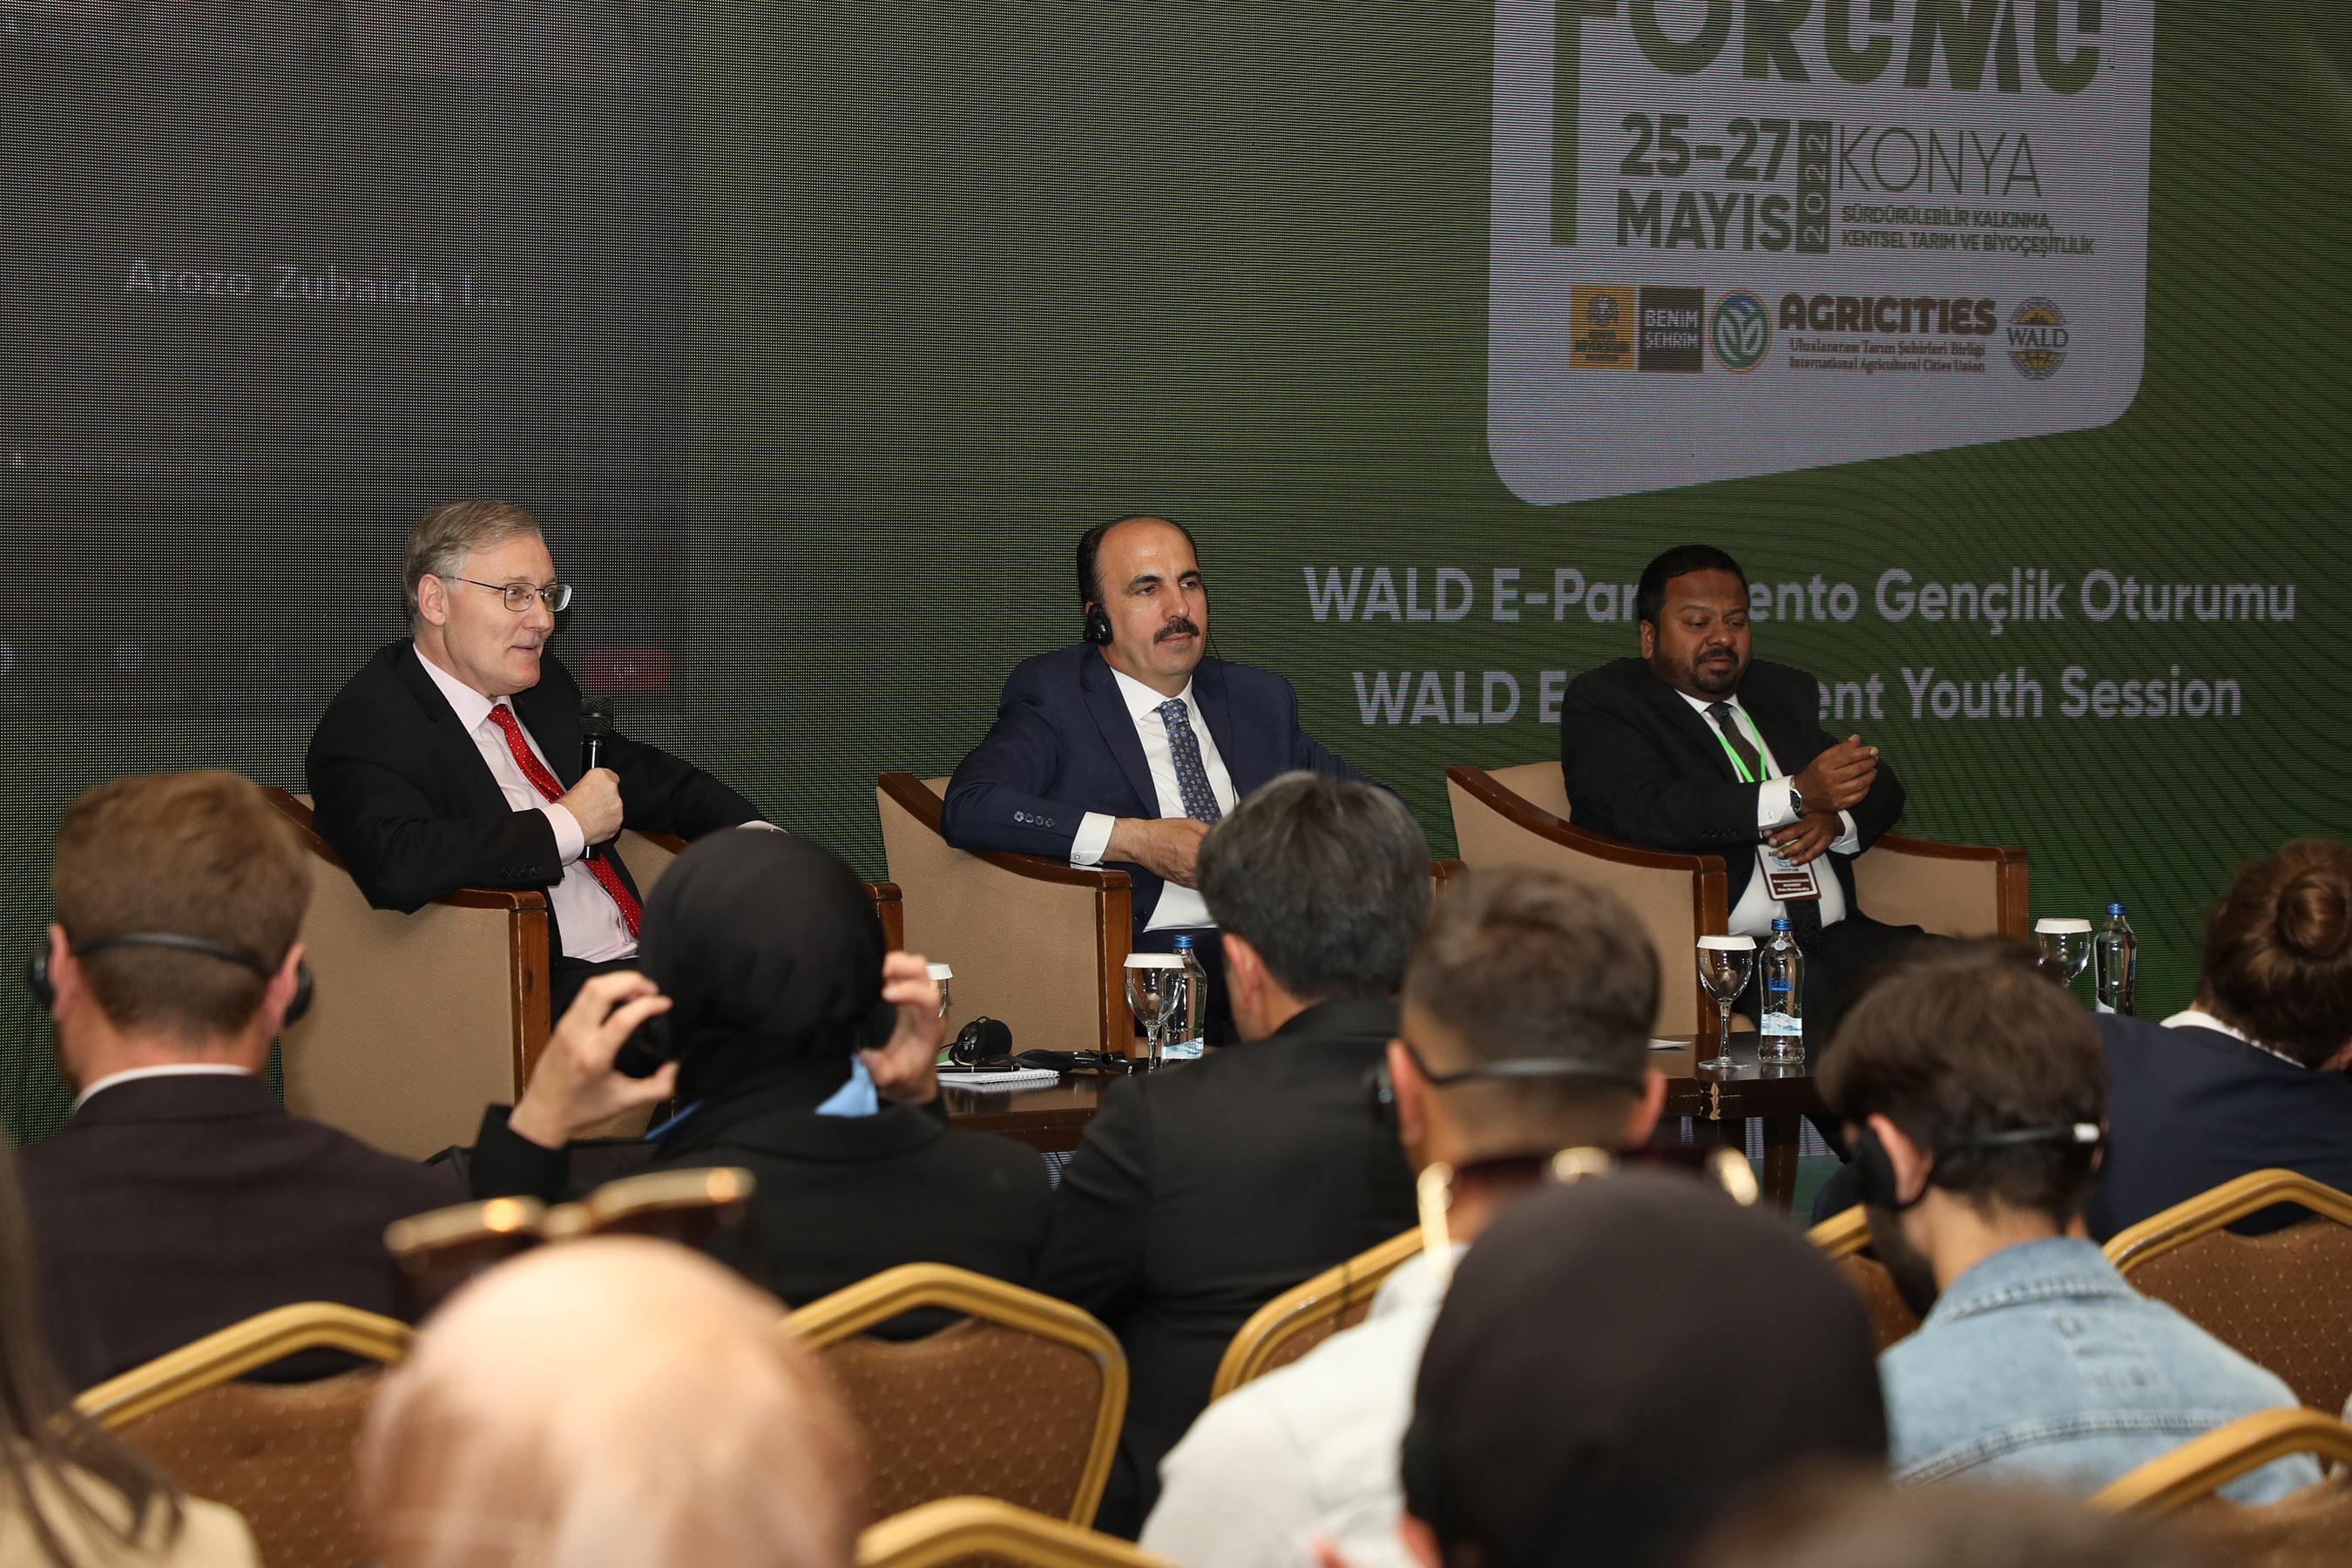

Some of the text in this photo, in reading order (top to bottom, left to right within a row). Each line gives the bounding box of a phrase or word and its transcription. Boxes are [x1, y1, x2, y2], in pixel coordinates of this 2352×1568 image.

[1620, 112, 1791, 181] 25-27
[1838, 123, 2043, 198] KONYA
[1804, 134, 1828, 243] 2022
[1617, 188, 1792, 252] MAYIS
[1842, 230, 1909, 248] KENTSEL
[1911, 232, 1957, 250] TARIM
[1960, 233, 1980, 250] VE
[125, 258, 253, 297] Arozo
[271, 264, 442, 305] Zubaida
[1779, 293, 1997, 336] AGRICITIES
[2006, 327, 2070, 348] WALD
[1303, 567, 1474, 621] WALD
[1875, 567, 2065, 635] Gençlik
[2080, 568, 2296, 622] Oturumu
[1353, 671, 1520, 725] WALD
[1901, 667, 2043, 719] Youth
[2060, 665, 2241, 718] Session
